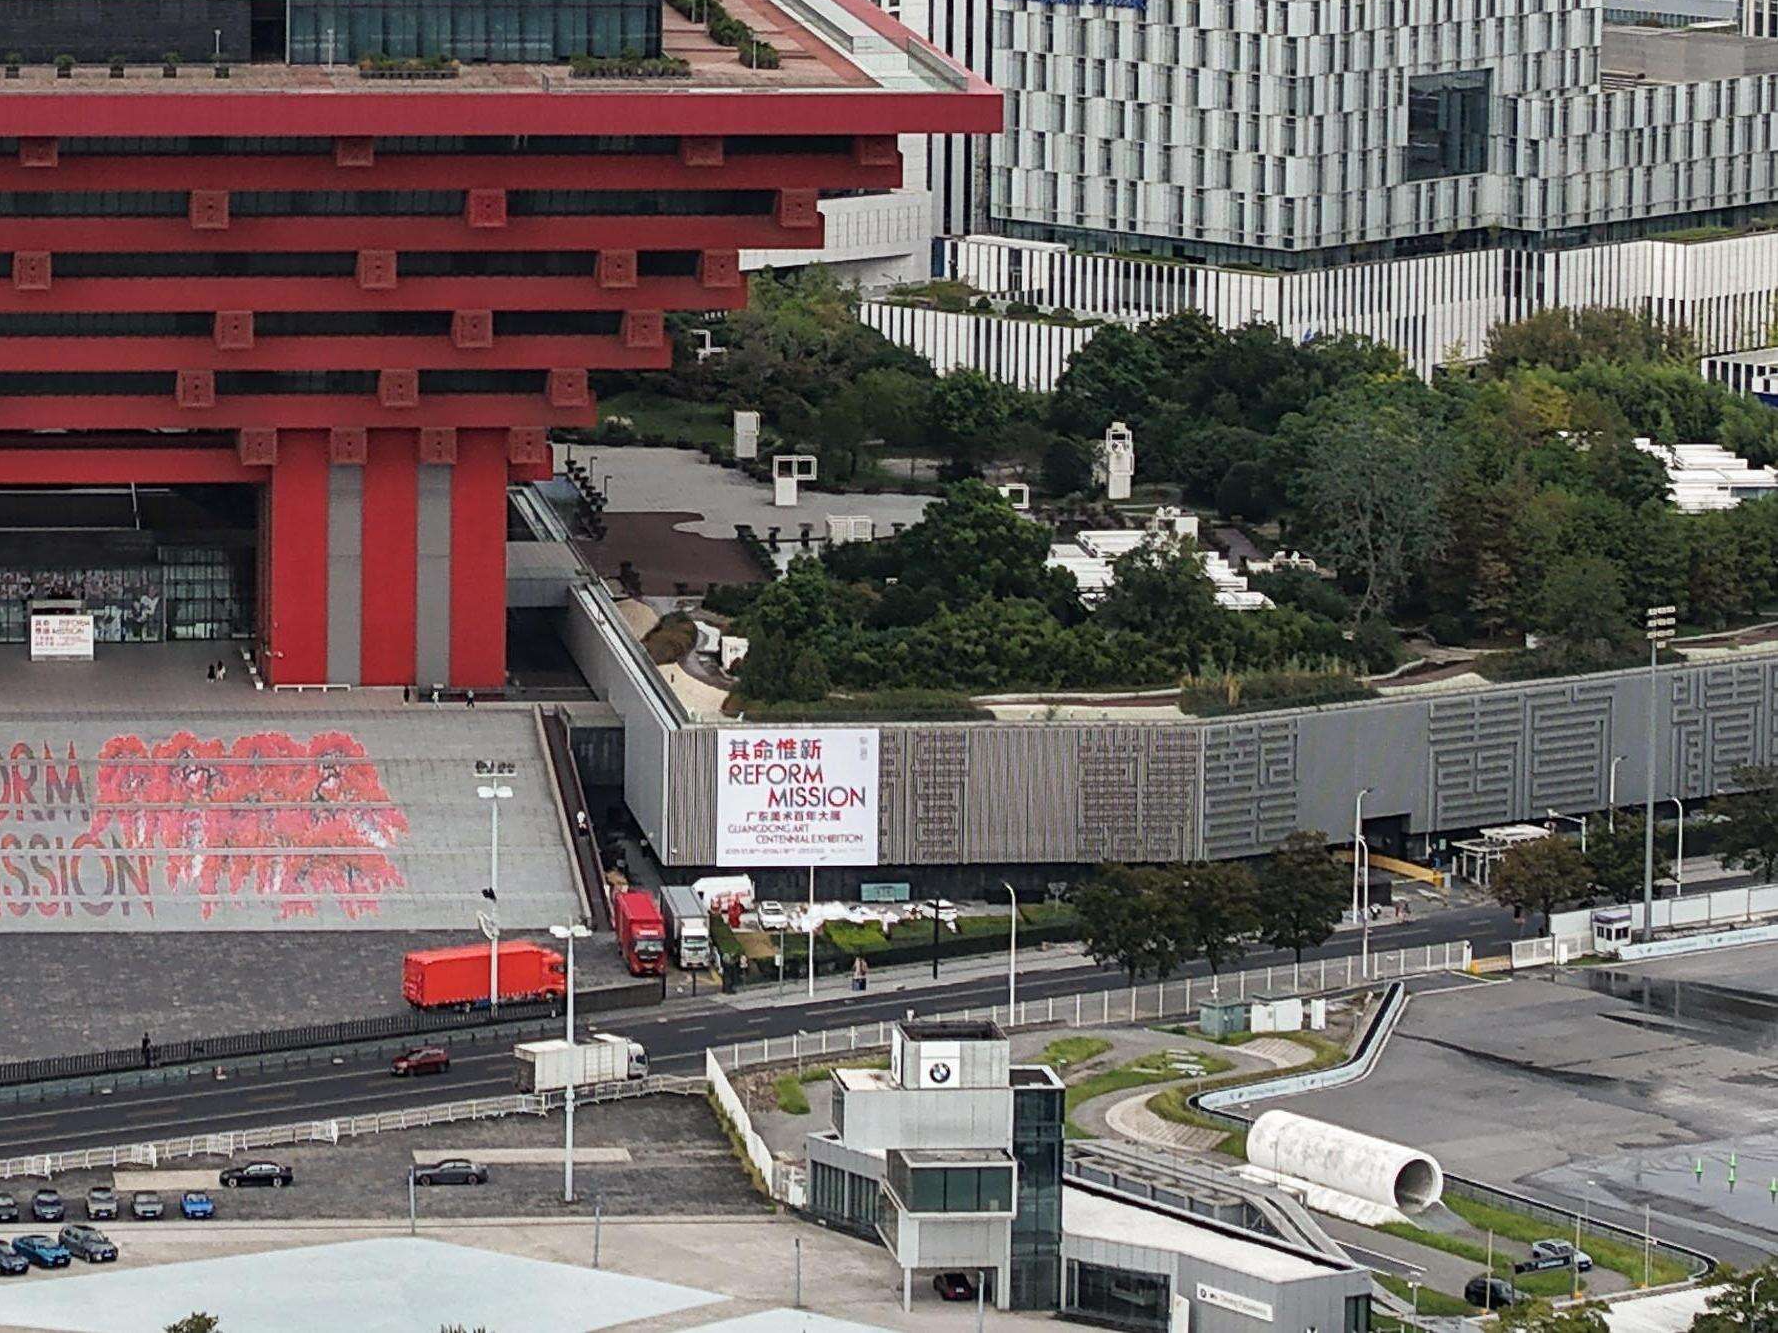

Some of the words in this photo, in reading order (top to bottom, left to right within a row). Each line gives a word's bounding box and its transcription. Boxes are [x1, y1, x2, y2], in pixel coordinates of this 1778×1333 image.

[728, 738, 822, 760] 其命惟新
[728, 763, 824, 785] REFORM
[767, 786, 866, 808] MISSION
